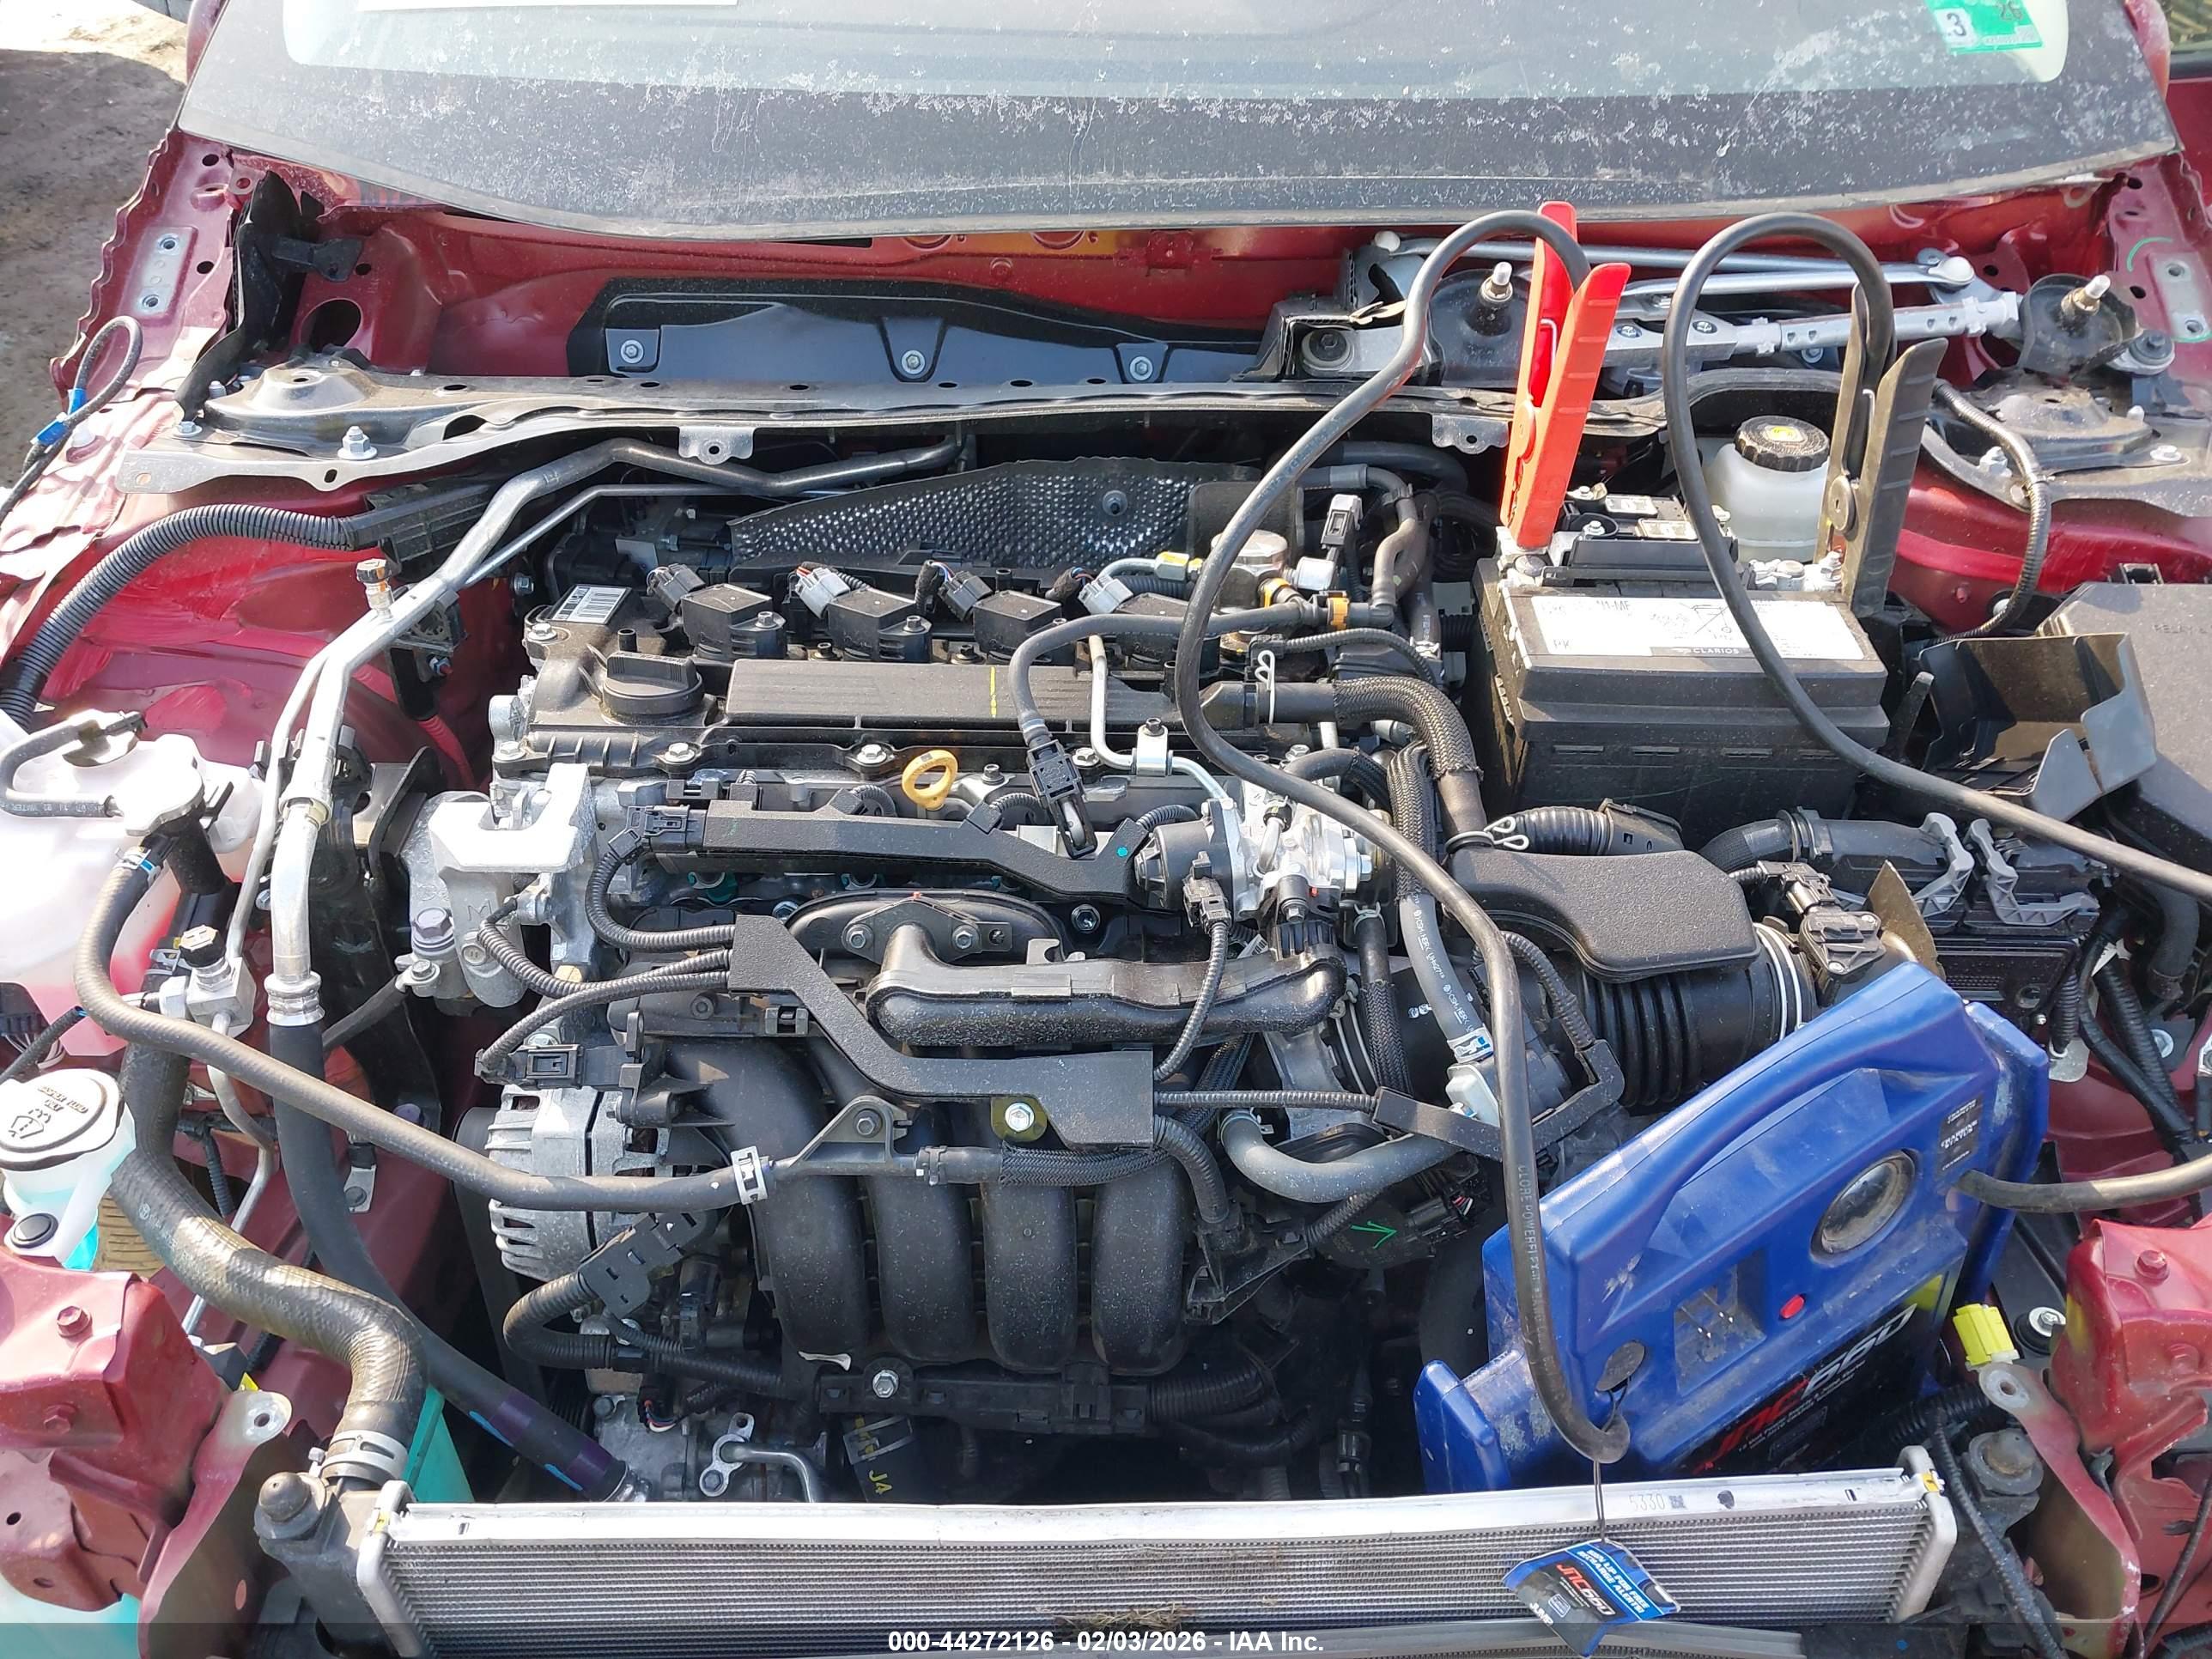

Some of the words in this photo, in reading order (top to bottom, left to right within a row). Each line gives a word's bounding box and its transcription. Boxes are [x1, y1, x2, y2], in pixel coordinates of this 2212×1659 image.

[1946, 12, 1967, 37] 3
[1516, 1164, 1533, 1202] CLORE
[1576, 1550, 1616, 1586] RECHARGE
[1602, 1560, 1617, 1576] UP
[1614, 1571, 1632, 1591] FOR
[1629, 1586, 1650, 1610] FREE
[1555, 1563, 1616, 1616] JNC660
[1528, 1602, 1554, 1626] JUMP
